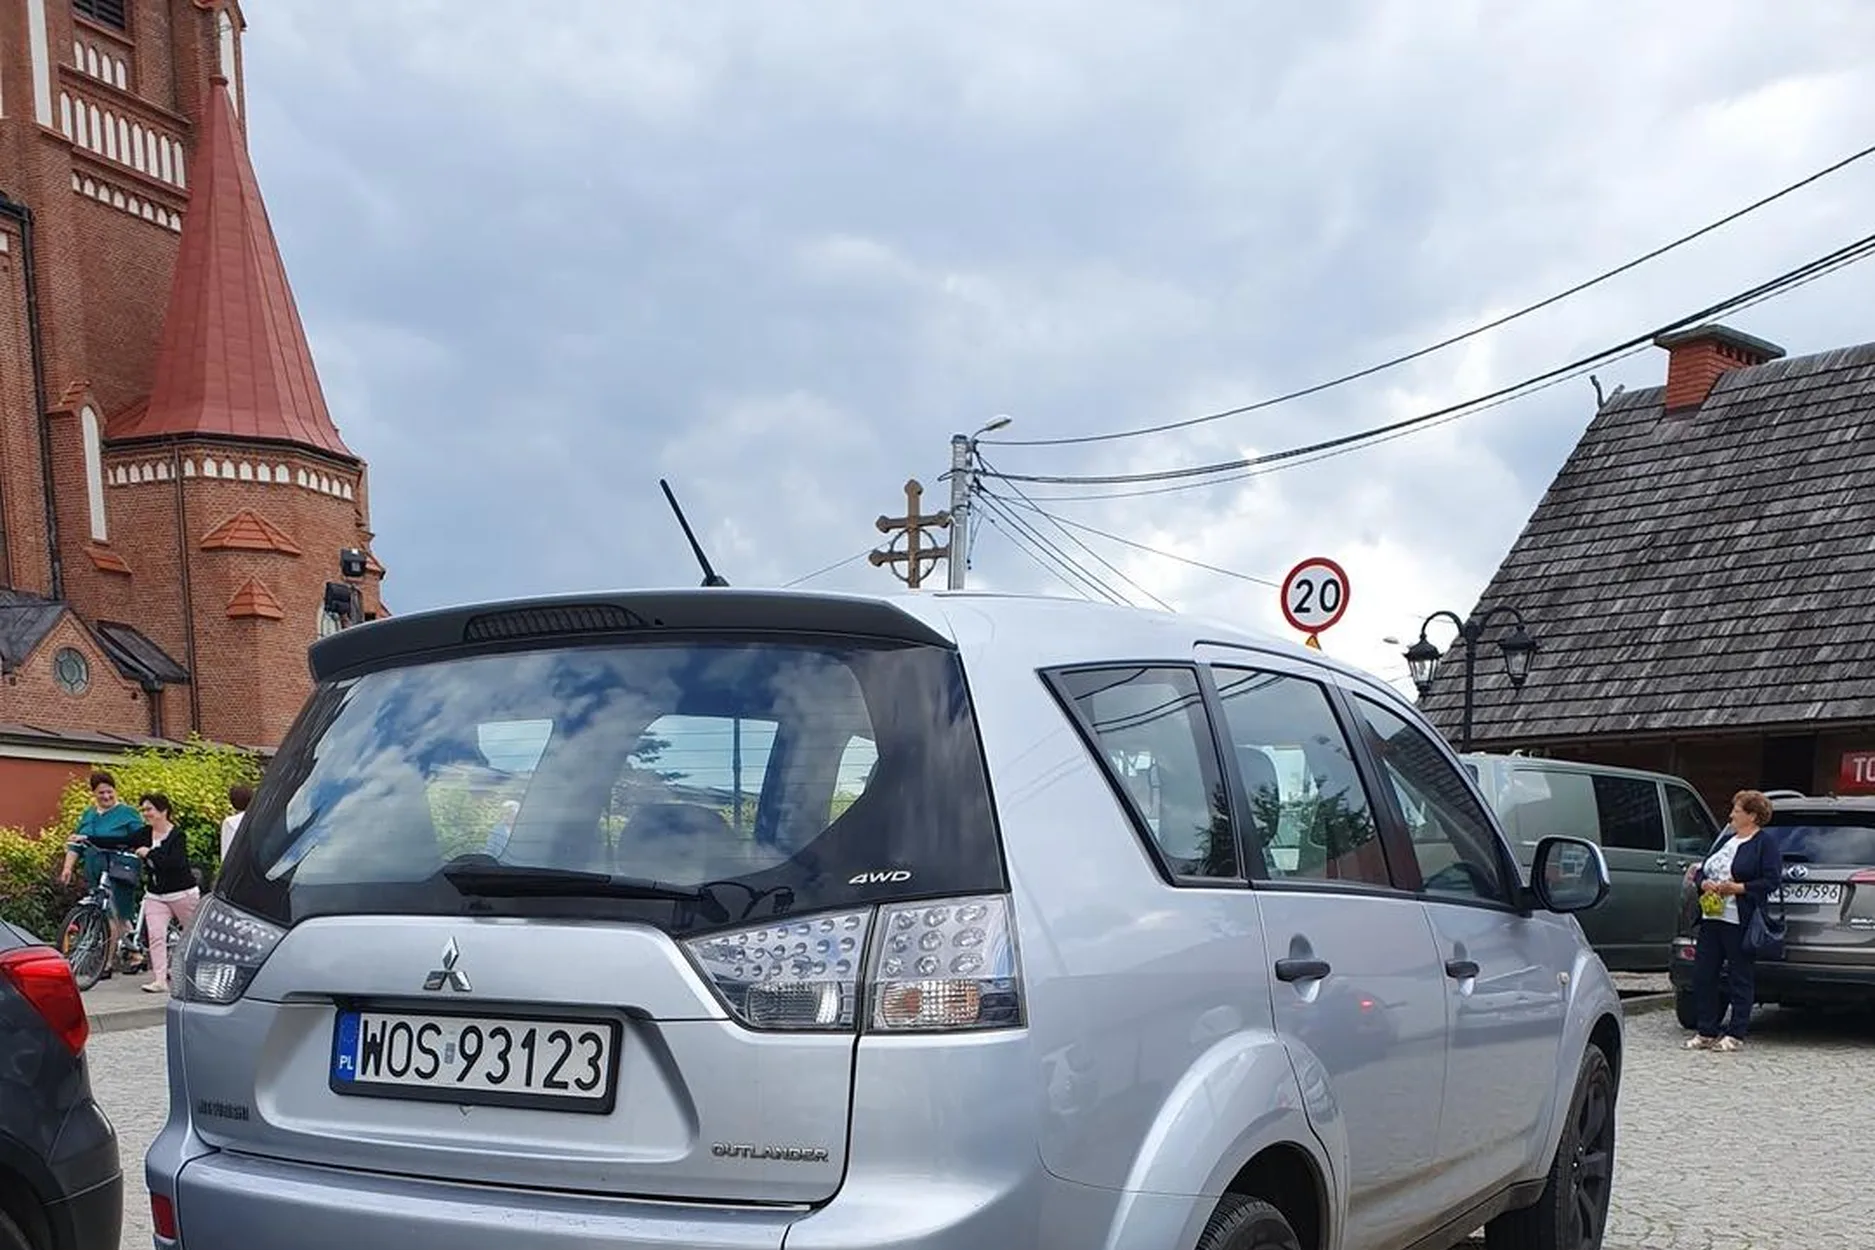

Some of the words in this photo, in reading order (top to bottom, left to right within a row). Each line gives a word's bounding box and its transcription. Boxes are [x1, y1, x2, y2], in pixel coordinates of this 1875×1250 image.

[1293, 578, 1341, 613] 20
[1795, 885, 1838, 899] 67596
[339, 1055, 354, 1070] PL
[361, 1019, 442, 1080] WOS
[456, 1025, 604, 1091] 93123
[712, 1143, 829, 1162] OUTLANDER
